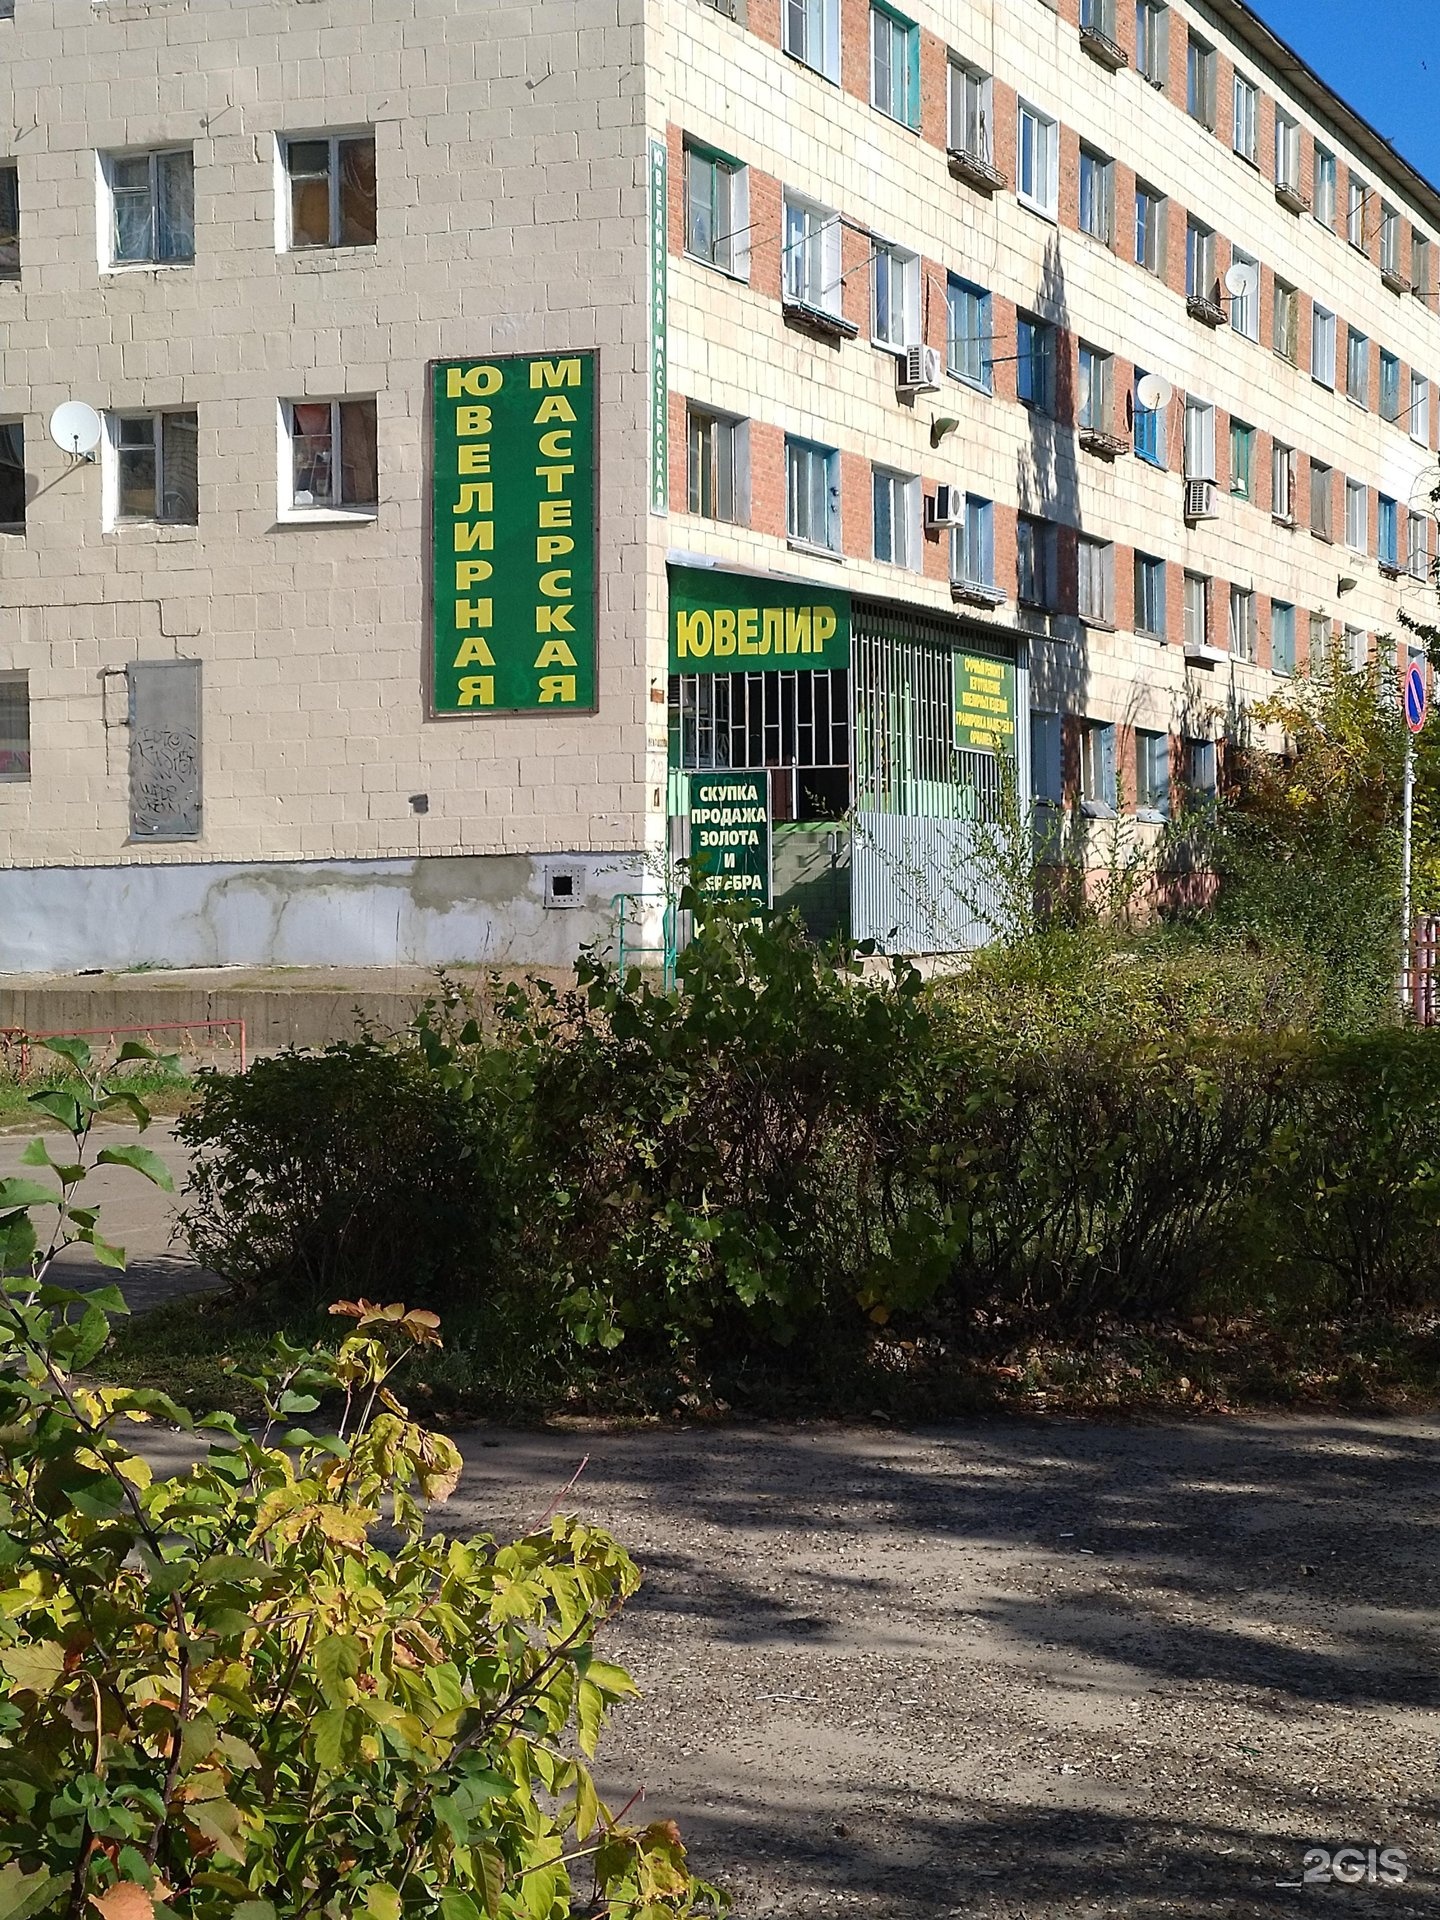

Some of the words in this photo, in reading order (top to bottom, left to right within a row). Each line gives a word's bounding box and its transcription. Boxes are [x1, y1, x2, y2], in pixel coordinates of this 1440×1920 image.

[653, 148, 664, 325] ЮВЕЛИРНАЯ
[655, 335, 664, 507] МАСТЕРСКАЯ
[446, 365, 504, 706] ЮВЕЛИРНАЯ
[529, 358, 582, 703] МАСТЕРСКАЯ
[677, 606, 837, 658] ЮВЕЛИР
[699, 785, 759, 802] СКУПКА
[691, 807, 767, 827] ПРОДАЖА
[700, 830, 760, 847] ЗОЛОТА
[724, 852, 736, 868] И
[699, 874, 763, 891] ЕРЕБРА
